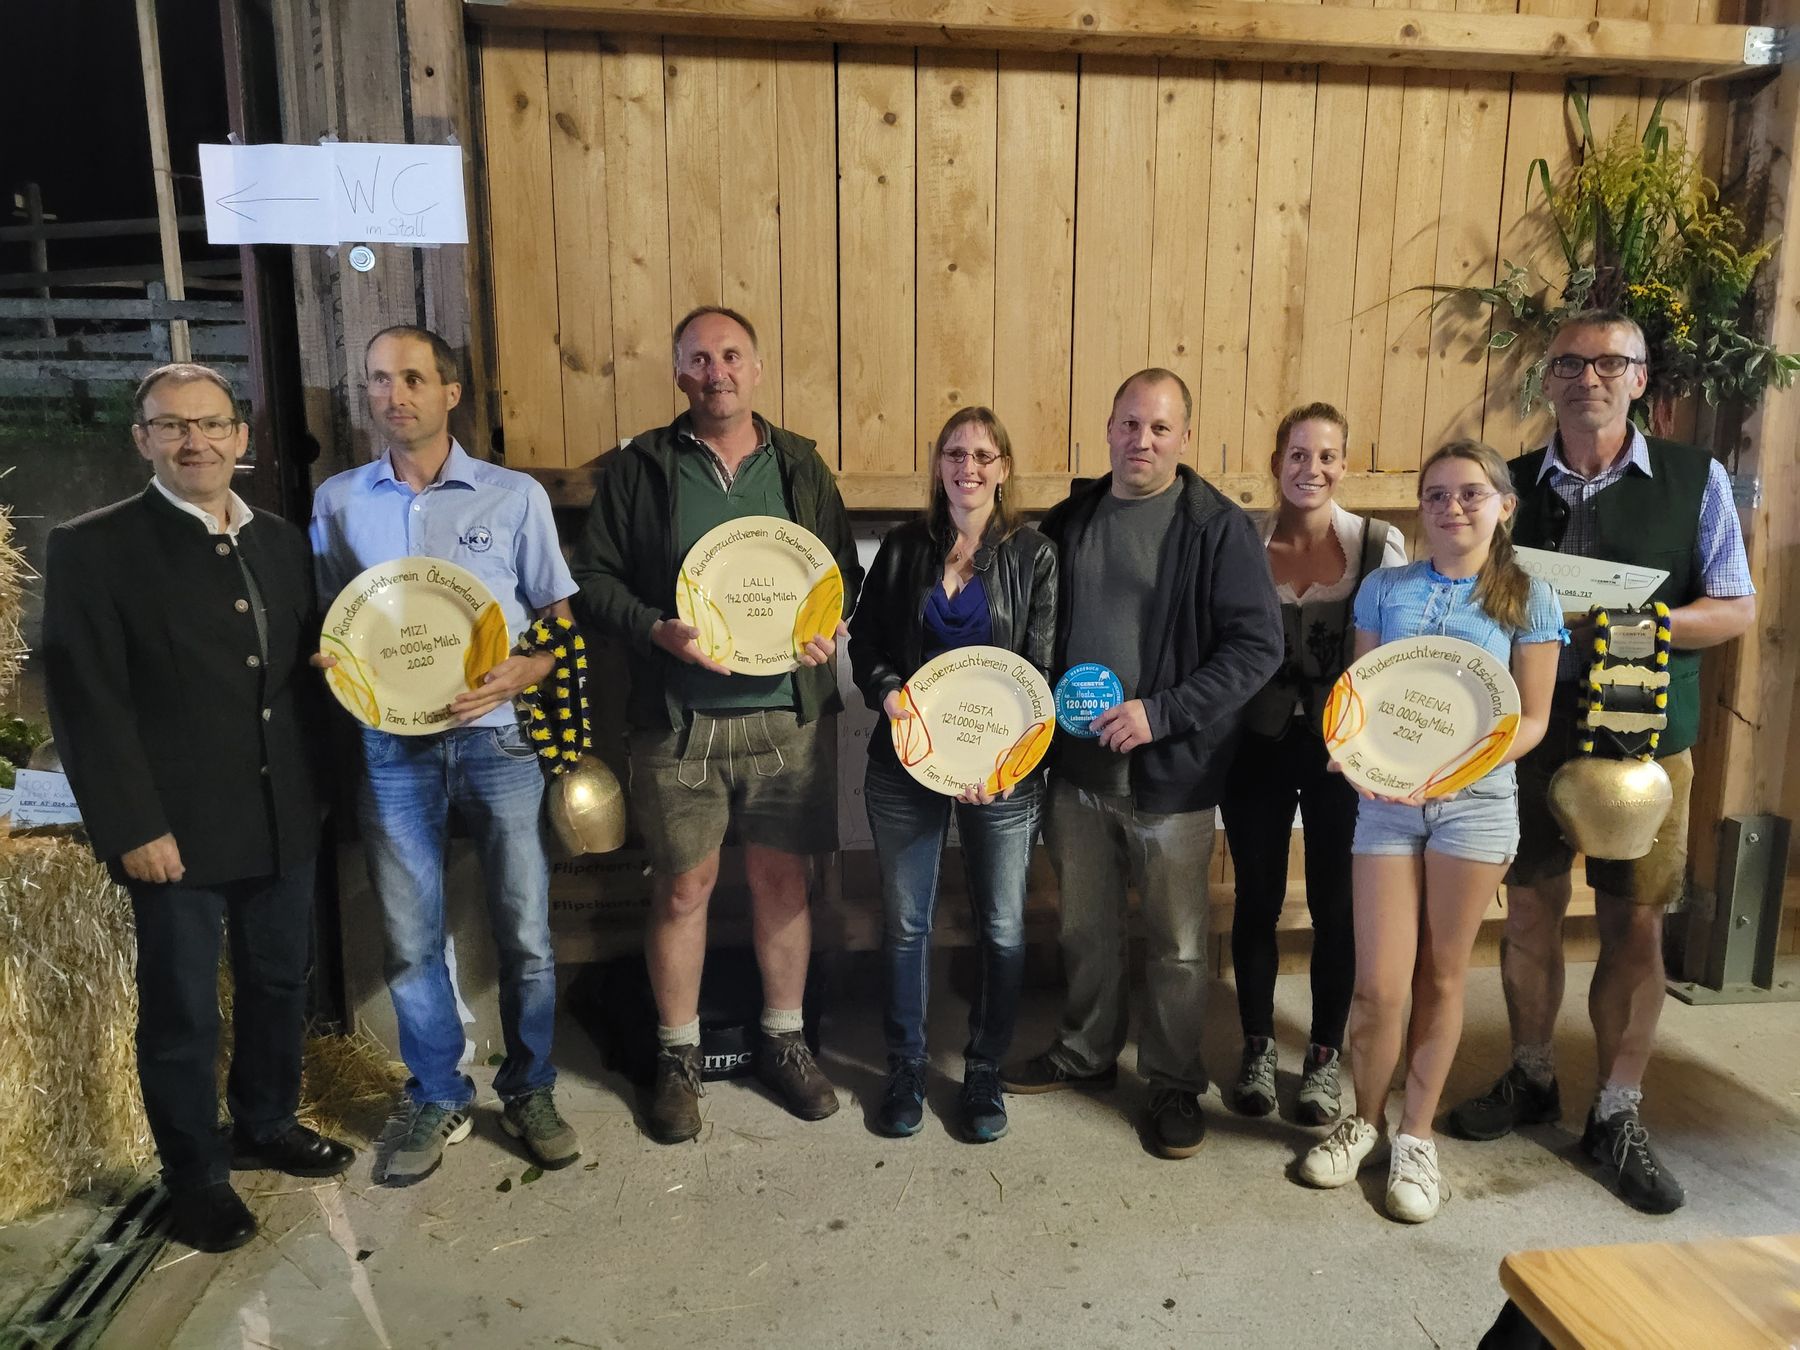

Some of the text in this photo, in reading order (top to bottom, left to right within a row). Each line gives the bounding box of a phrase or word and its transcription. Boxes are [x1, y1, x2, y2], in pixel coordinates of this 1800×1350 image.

[336, 155, 440, 215] WC
[366, 216, 426, 238] im Stall
[459, 536, 489, 545] LKV
[691, 528, 768, 576] Rinderzuchtverein
[743, 577, 775, 587] LALLI
[332, 566, 486, 636] Rinderzuchtverein Ötscherland
[773, 592, 797, 601] Milch
[747, 608, 773, 618] 2020
[400, 624, 428, 638] MIZI
[433, 634, 461, 649] Milch
[407, 655, 435, 670] 2020
[913, 653, 1008, 693] Rinderzuchtverein
[1356, 645, 1507, 718] Rinderzuchtverein Ötscherland
[958, 702, 993, 716] HOSTA
[1066, 699, 1110, 711] 120.000 kg
[1404, 689, 1451, 714] VERENA
[986, 722, 1009, 736] Milch
[1393, 726, 1423, 744] 2021
[1428, 718, 1455, 737] Milch
[957, 732, 981, 746] 2021
[1365, 767, 1414, 790] Görlitzer
[703, 1053, 752, 1069] ITEC
